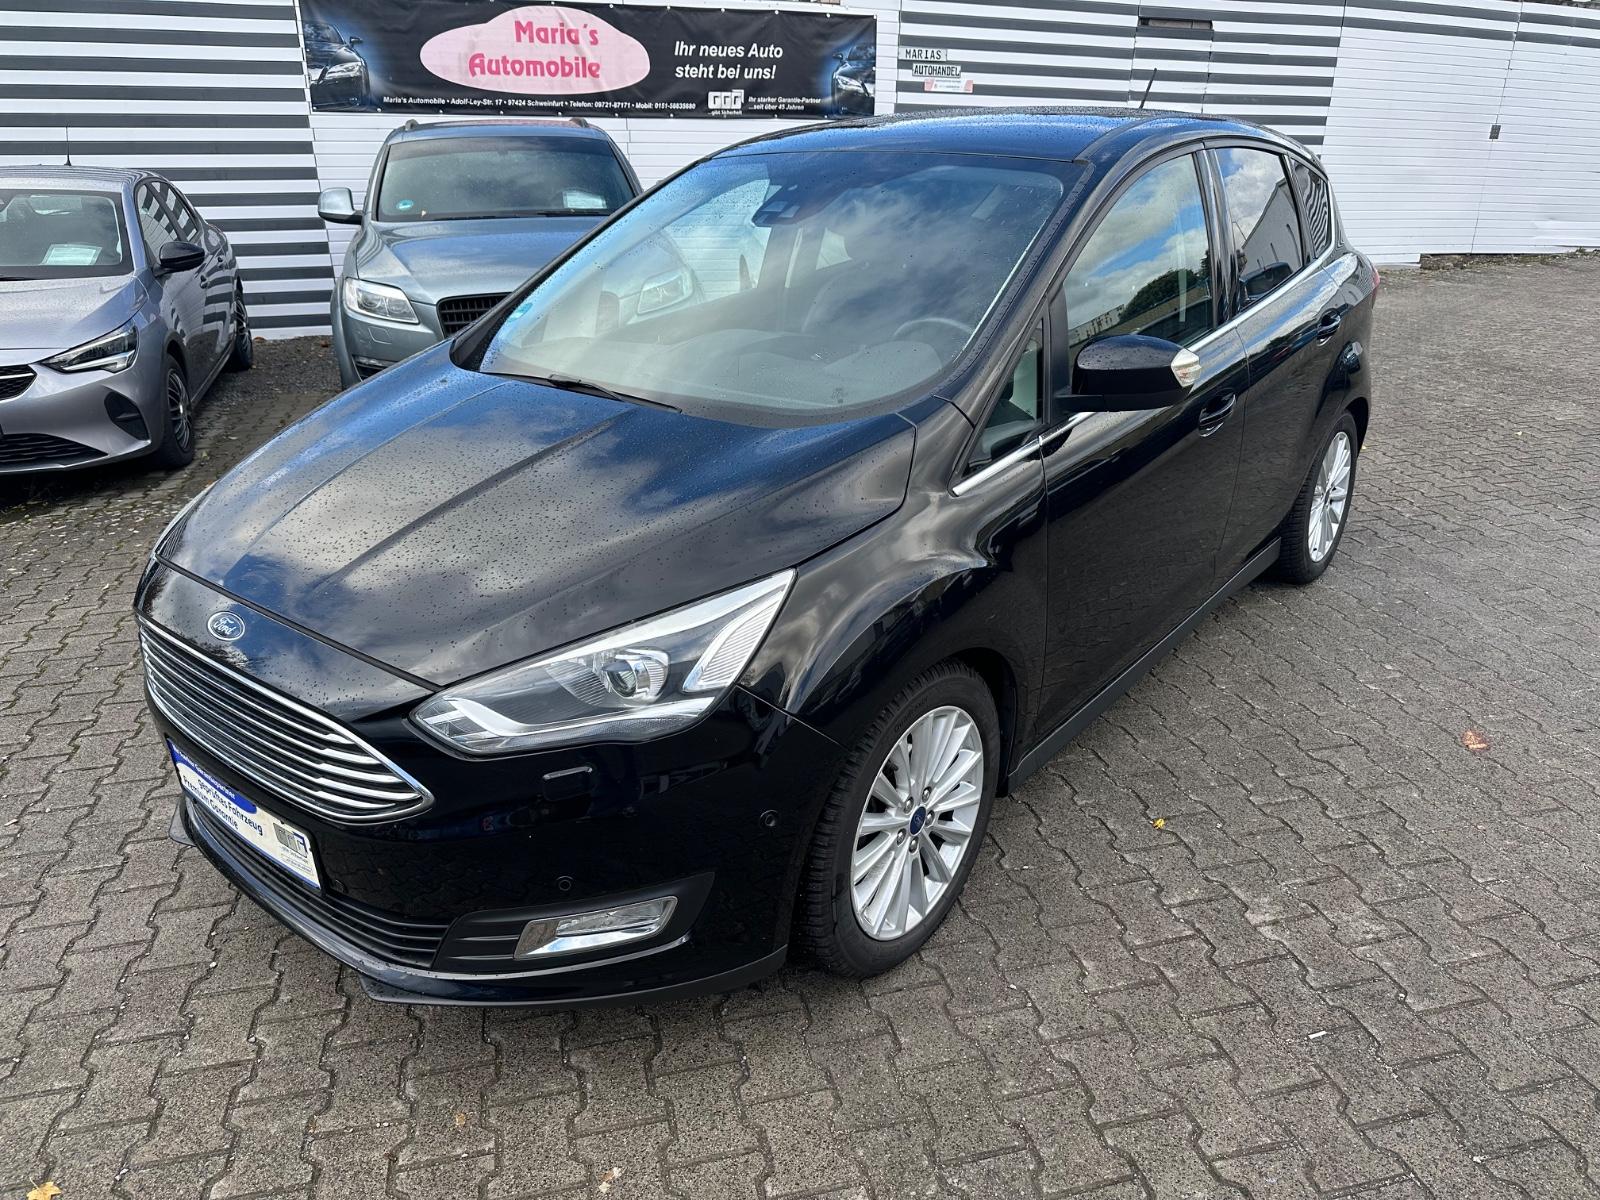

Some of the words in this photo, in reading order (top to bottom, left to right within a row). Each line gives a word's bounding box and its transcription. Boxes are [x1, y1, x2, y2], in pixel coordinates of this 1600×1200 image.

[674, 41, 696, 56] Ihr
[699, 45, 745, 57] neues
[748, 43, 784, 58] Auto
[905, 48, 942, 60] MARIAS
[468, 53, 601, 79] Automobile
[675, 64, 714, 78] steht
[717, 64, 741, 79] bei
[744, 65, 777, 79] uns!
[914, 65, 960, 77] AUTOHANDEL
[408, 97, 446, 105] Automobile
[507, 99, 526, 107] 97424
[527, 99, 564, 108] Schweinfurt
[569, 100, 593, 108] Telefon:
[227, 801, 264, 837] Fahrzeug
